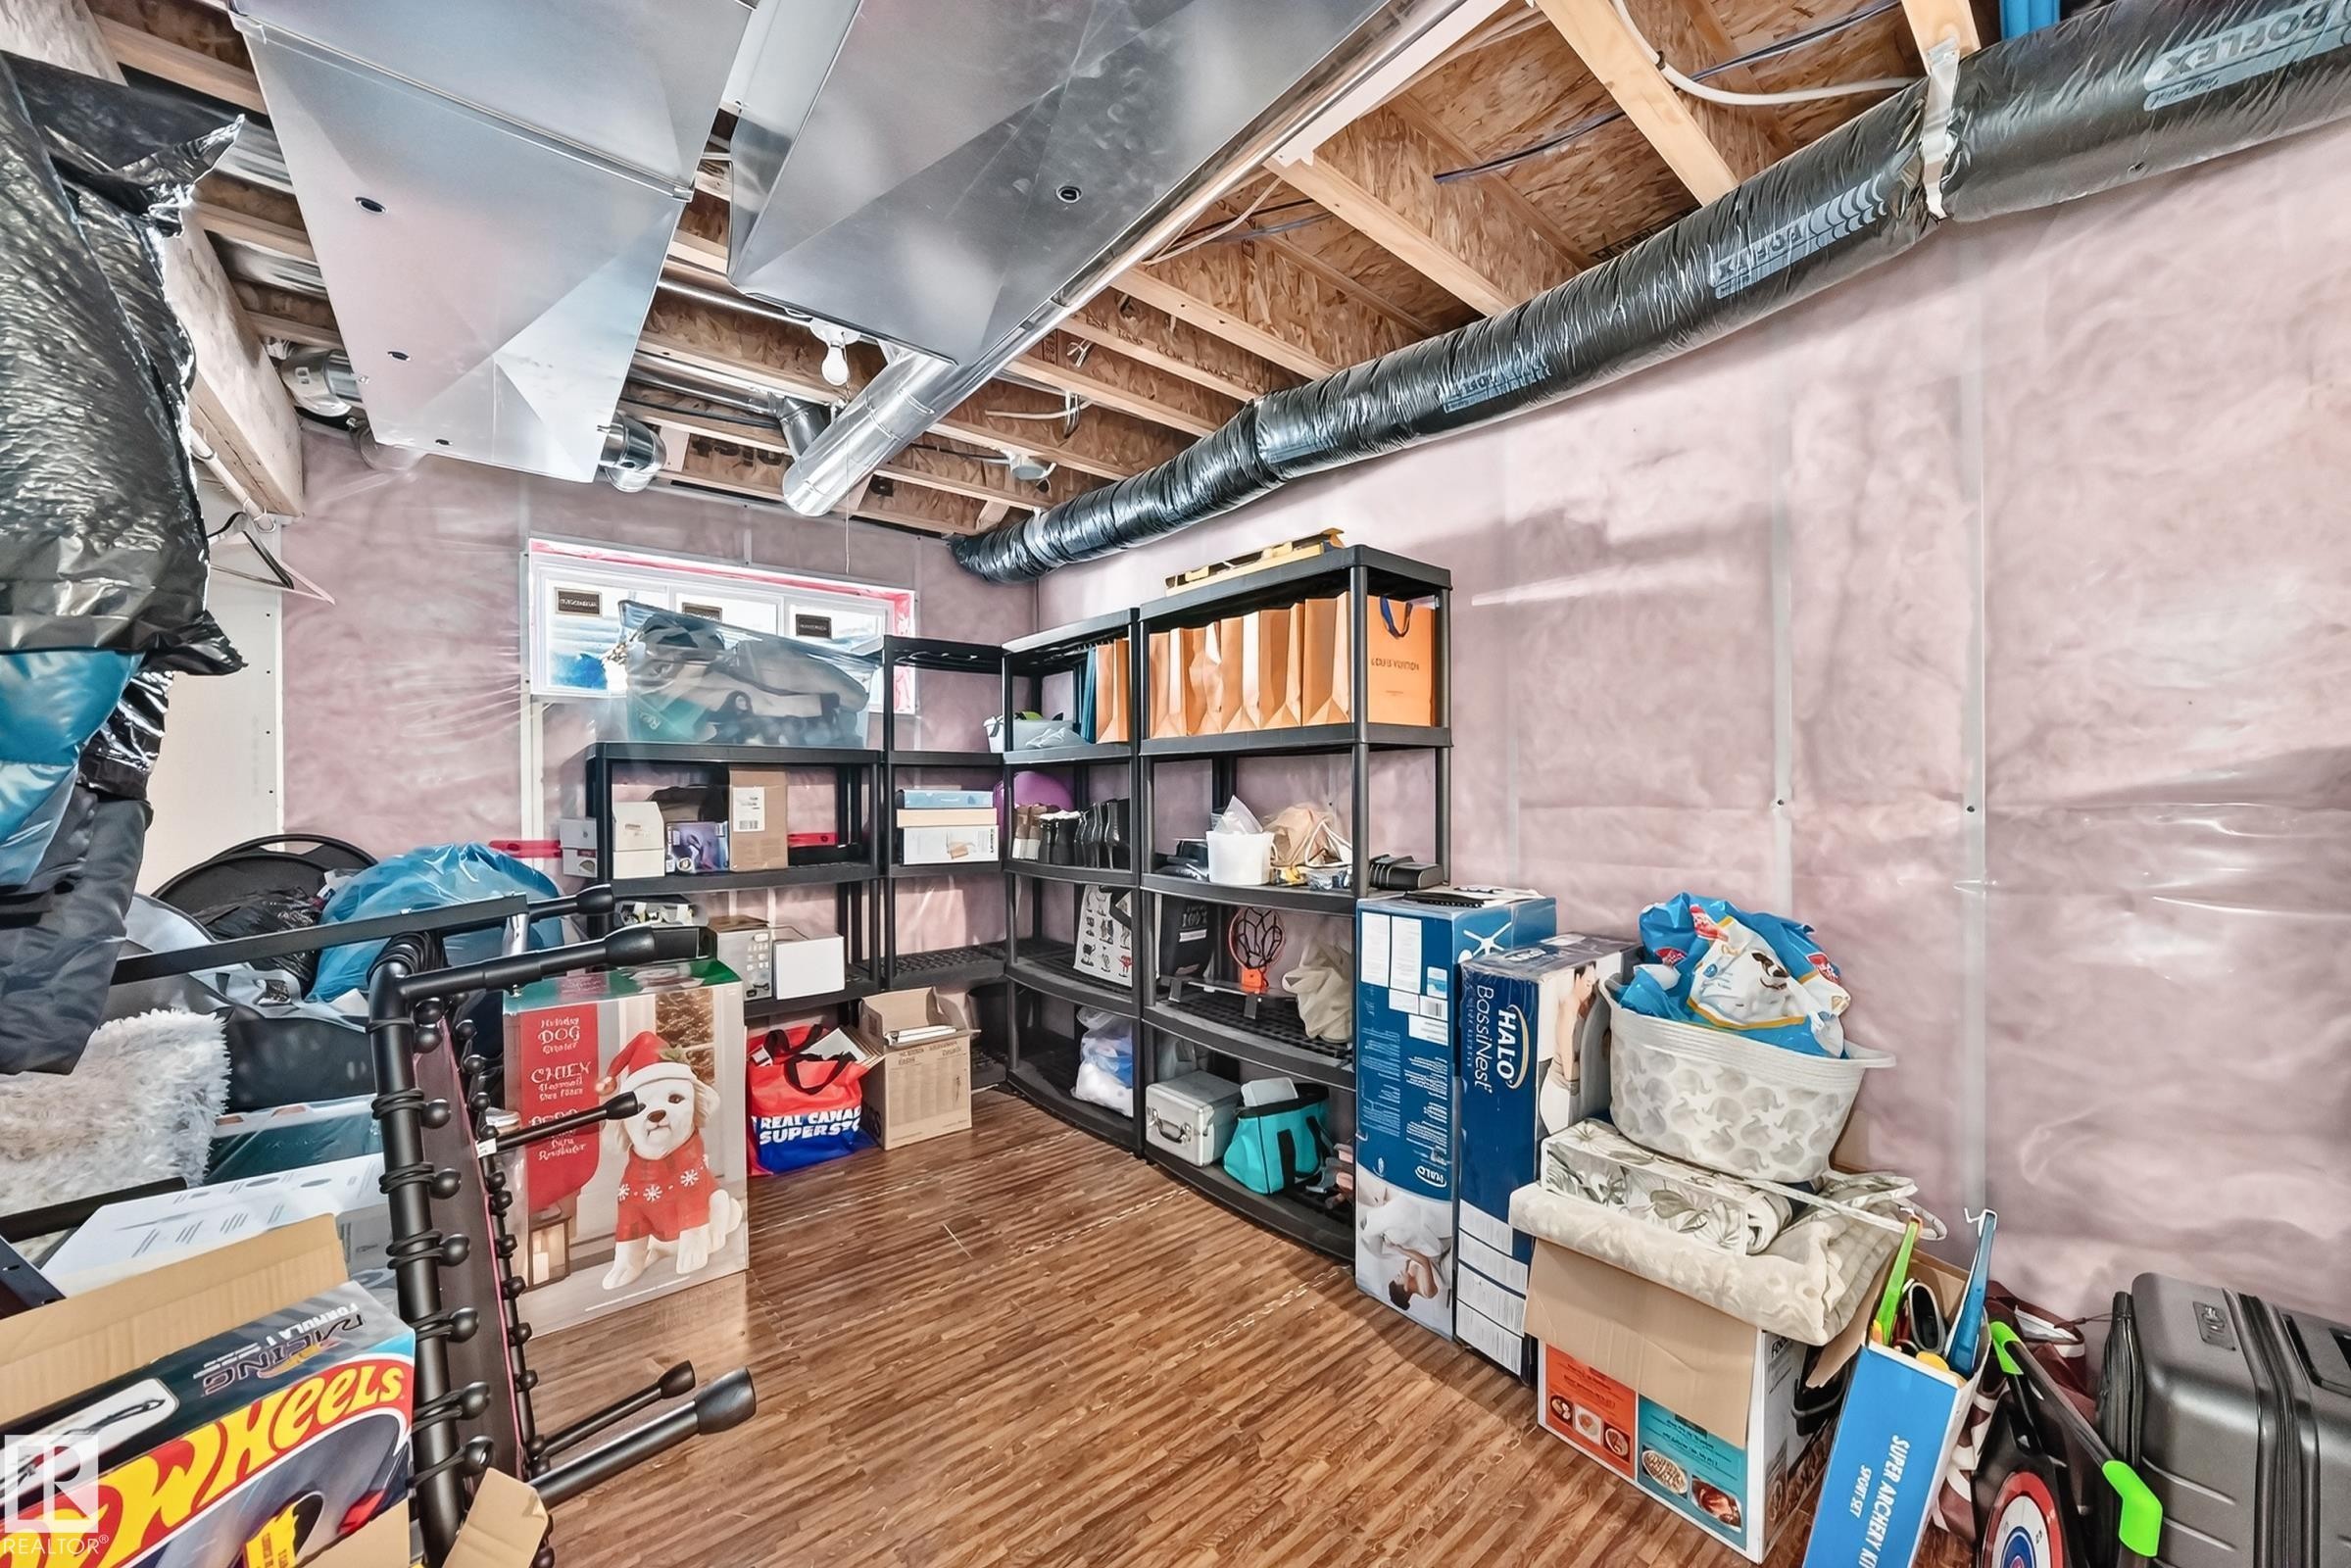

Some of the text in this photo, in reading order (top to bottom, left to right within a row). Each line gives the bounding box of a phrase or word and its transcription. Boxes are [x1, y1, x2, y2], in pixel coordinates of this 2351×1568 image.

[537, 1025, 581, 1045] DOG
[1496, 1008, 1516, 1081] HALO
[760, 1114, 804, 1130] REAL
[278, 1302, 361, 1341] FORMULA
[202, 1313, 366, 1396] RACING
[1883, 1435, 1910, 1483] SUPER
[1865, 1480, 1897, 1552] ARCHERY
